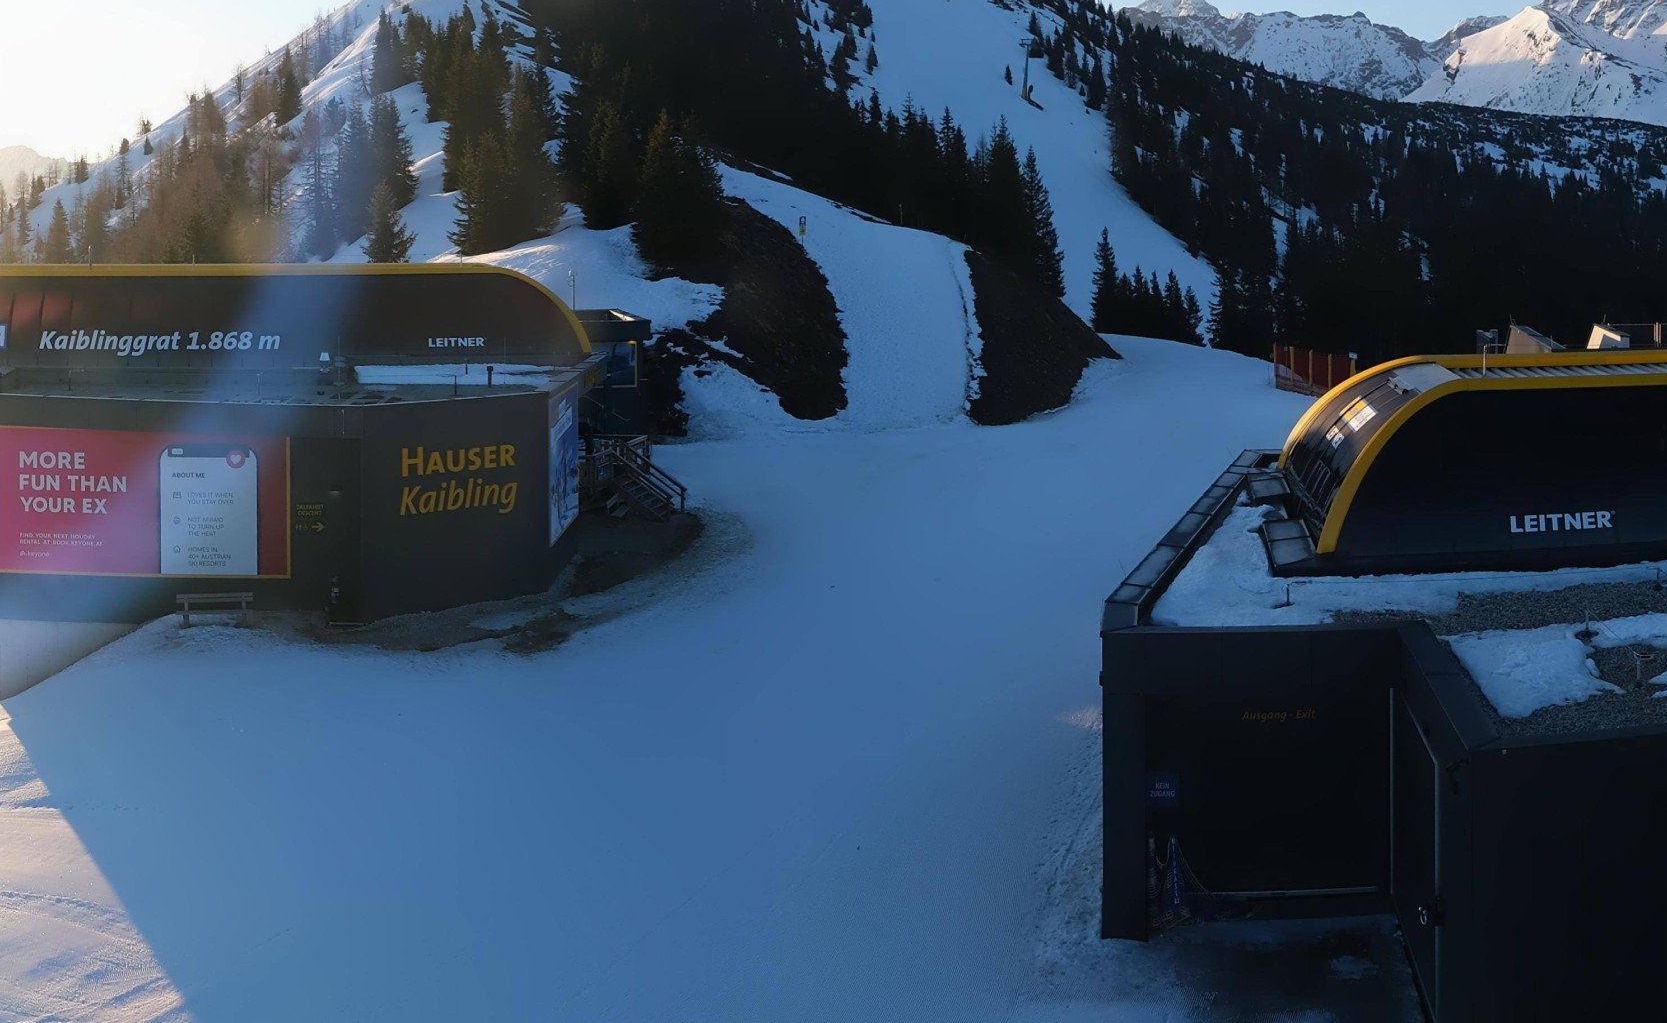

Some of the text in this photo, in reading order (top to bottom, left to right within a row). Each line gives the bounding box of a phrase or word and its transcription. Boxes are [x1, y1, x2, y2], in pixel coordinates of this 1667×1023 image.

[39, 330, 280, 356] Kaiblinggrat 1.868 m
[428, 337, 485, 348] LEITNER
[19, 451, 85, 470] MORE
[401, 444, 516, 477] HAUSER
[19, 474, 127, 493] FUN THAN
[20, 496, 108, 514] YOUR EX
[400, 478, 518, 516] Kaibling
[1509, 510, 1613, 533] LEITNER
[1242, 711, 1288, 722] Ausgang
[1295, 709, 1318, 720] Exit
[1150, 790, 1176, 798] ZUGANG
